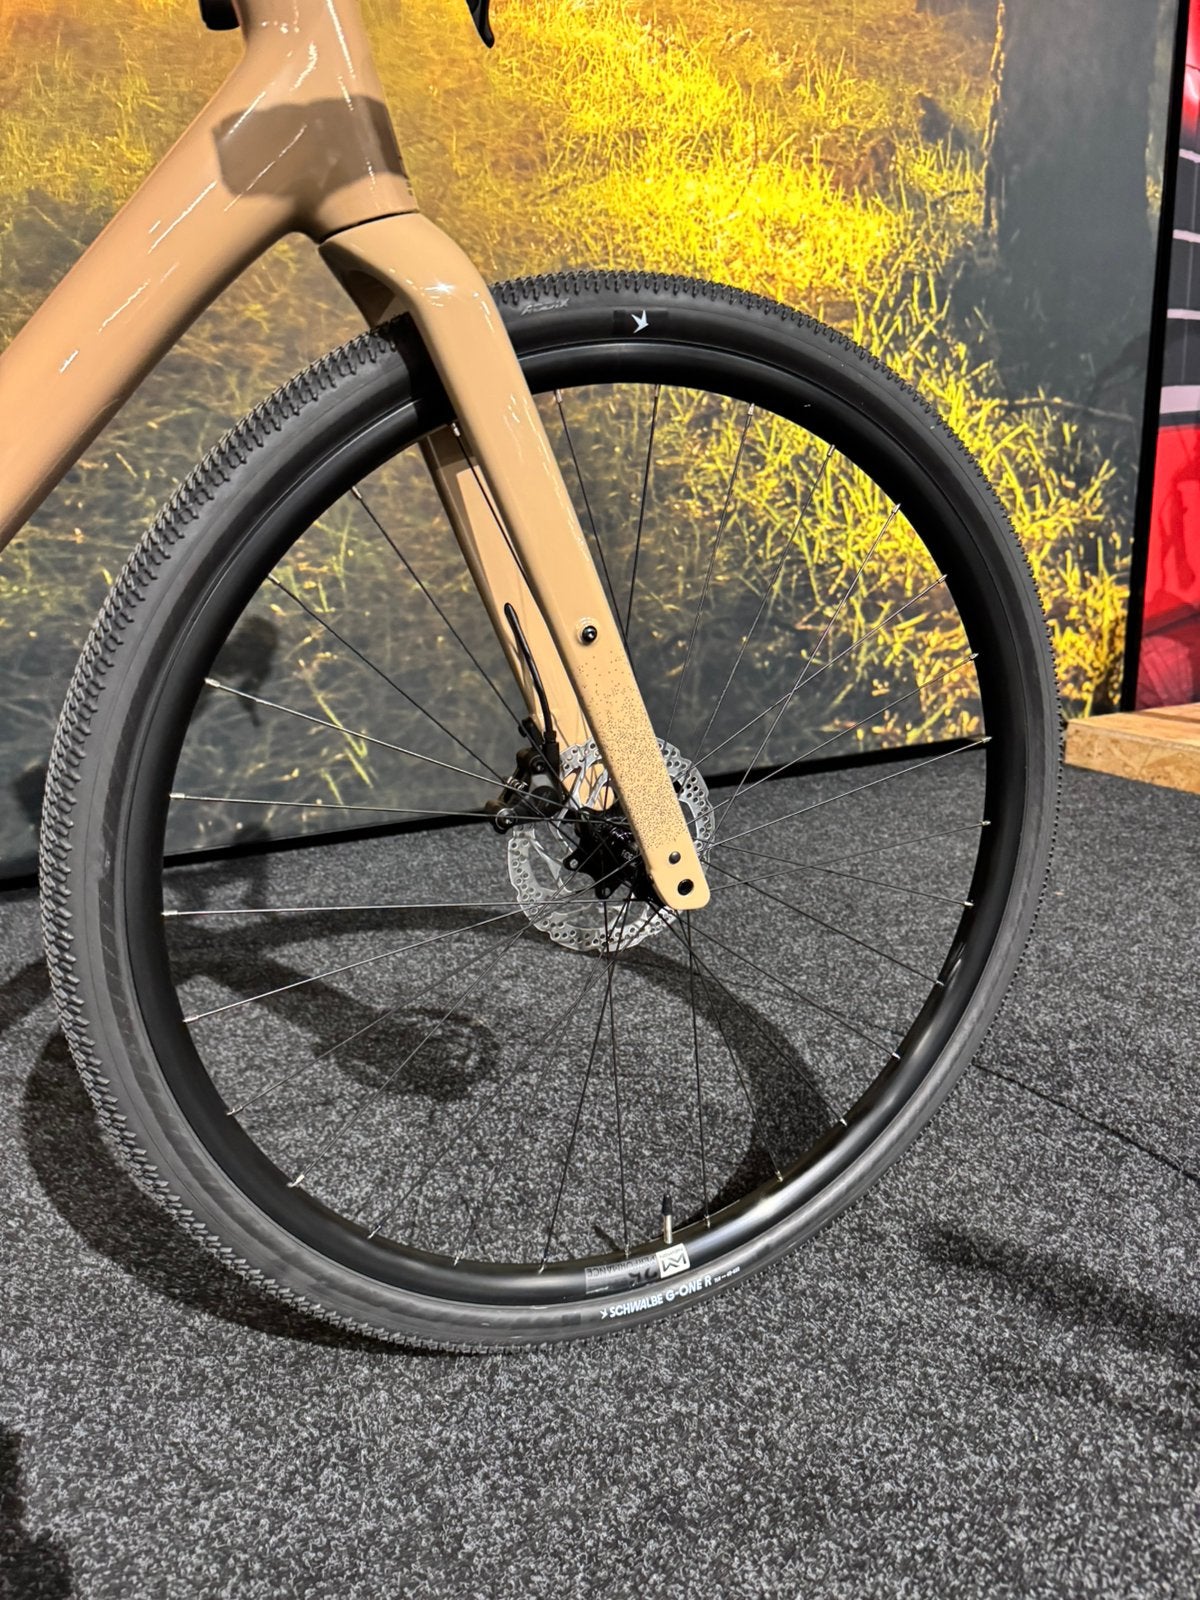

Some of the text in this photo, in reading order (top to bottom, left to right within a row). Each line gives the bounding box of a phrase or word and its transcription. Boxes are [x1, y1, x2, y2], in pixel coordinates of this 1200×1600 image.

[609, 1293, 664, 1318] SCHWALBE
[665, 1279, 703, 1302] G-ONE
[704, 1274, 712, 1288] R
